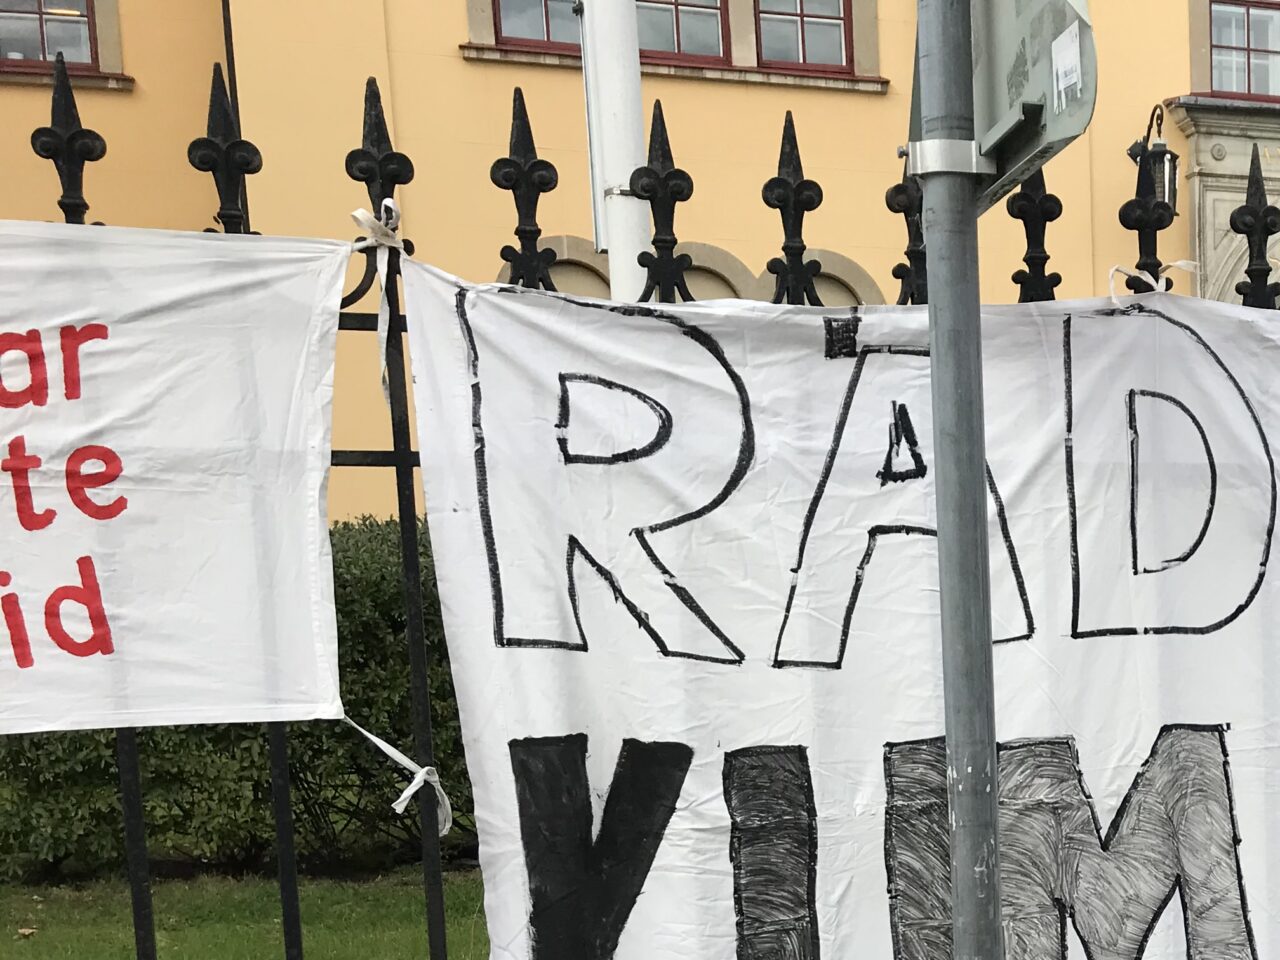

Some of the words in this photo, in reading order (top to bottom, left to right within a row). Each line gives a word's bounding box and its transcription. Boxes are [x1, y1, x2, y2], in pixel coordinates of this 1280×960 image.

[0, 324, 109, 408] ar
[0, 436, 129, 531] te
[0, 556, 114, 668] id
